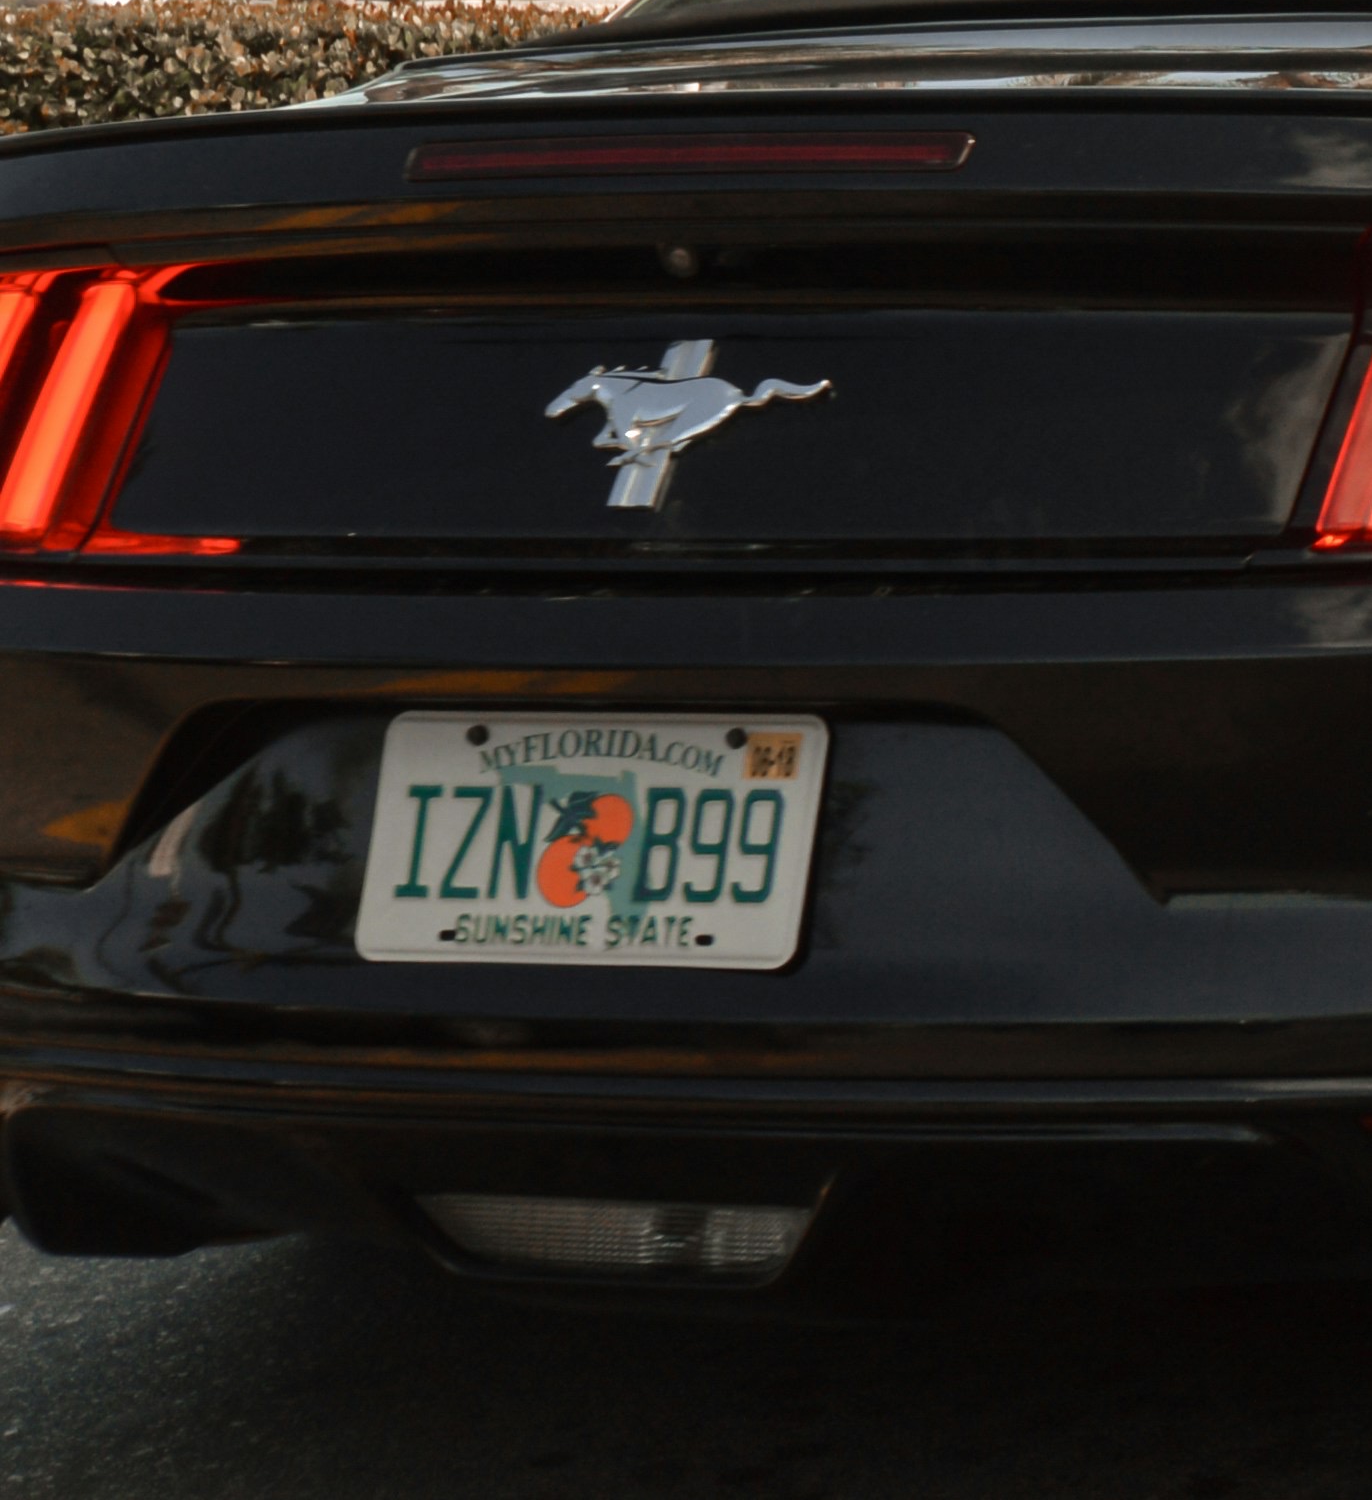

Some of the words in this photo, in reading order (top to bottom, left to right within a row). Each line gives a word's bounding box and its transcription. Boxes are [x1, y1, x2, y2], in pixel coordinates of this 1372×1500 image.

[395, 784, 543, 900] IZN
[632, 786, 785, 903] B99
[454, 913, 593, 946] SUNSHINE
[604, 915, 695, 948] STATE
